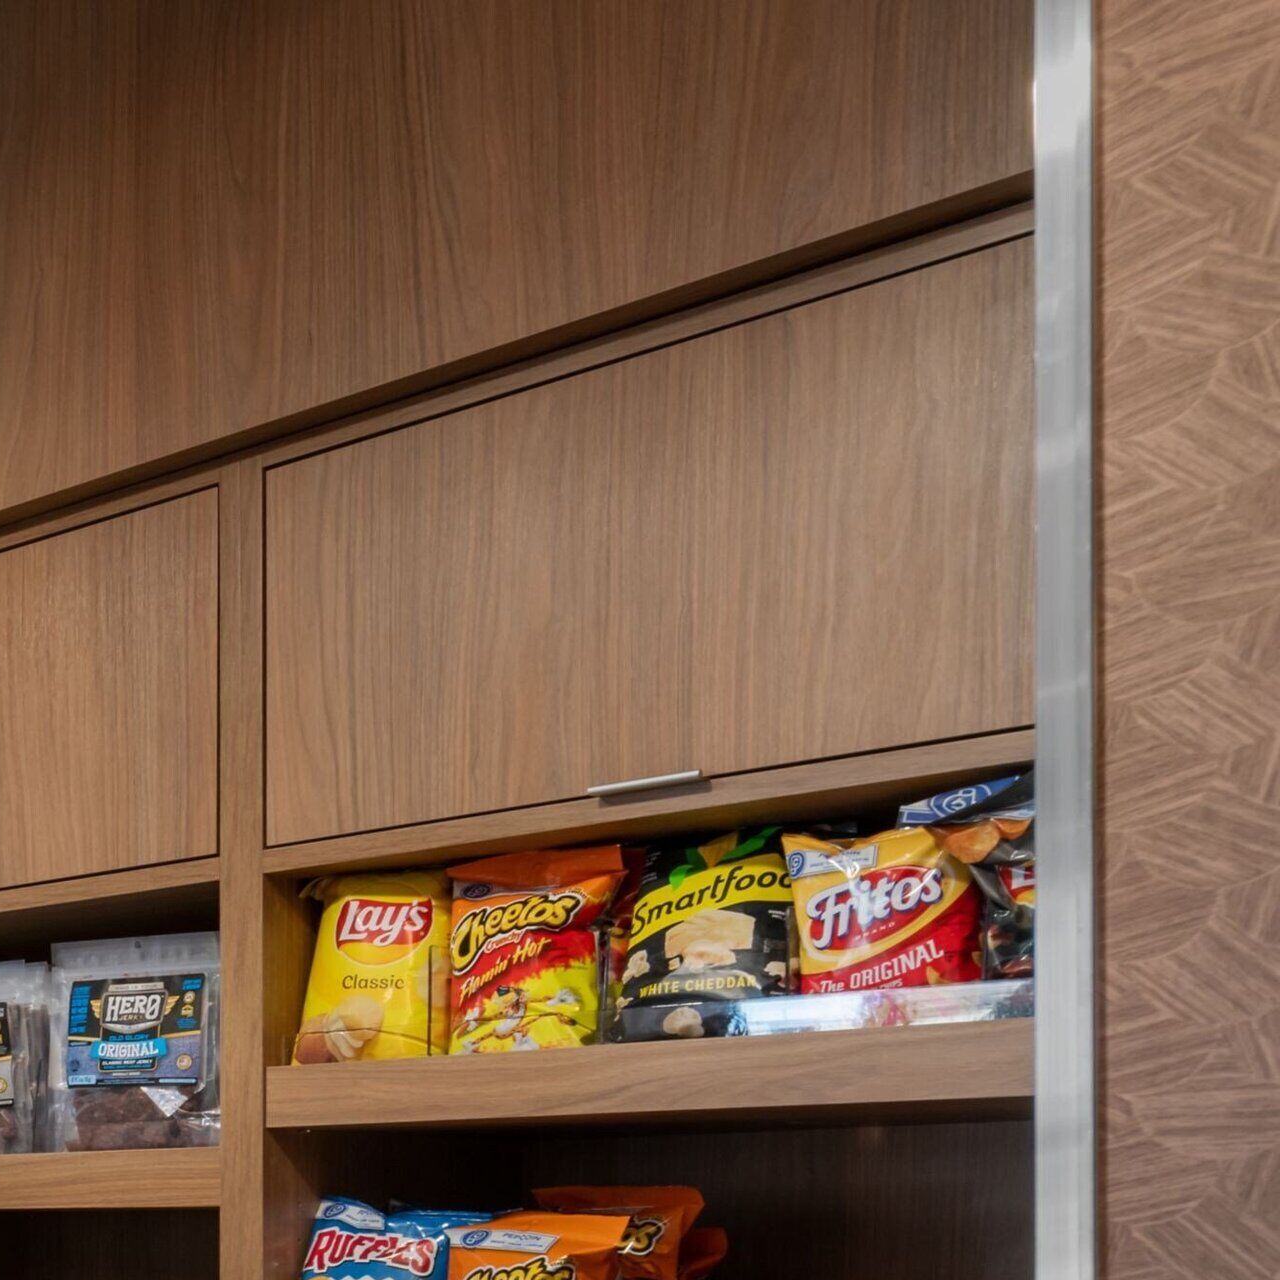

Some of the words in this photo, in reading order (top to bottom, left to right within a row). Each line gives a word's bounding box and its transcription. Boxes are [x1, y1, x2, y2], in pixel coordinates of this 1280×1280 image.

[339, 900, 428, 946] Lay's
[805, 866, 944, 949] Fritos
[452, 893, 583, 975] Cheetos
[515, 937, 551, 963] Hot
[342, 974, 405, 990] Classic
[639, 980, 679, 998] WHITE
[684, 974, 756, 992] CHEDDAR
[849, 938, 945, 990] ORIGINAL
[98, 1042, 159, 1058] ORIGINAL
[305, 1227, 438, 1276] RUFFLES
